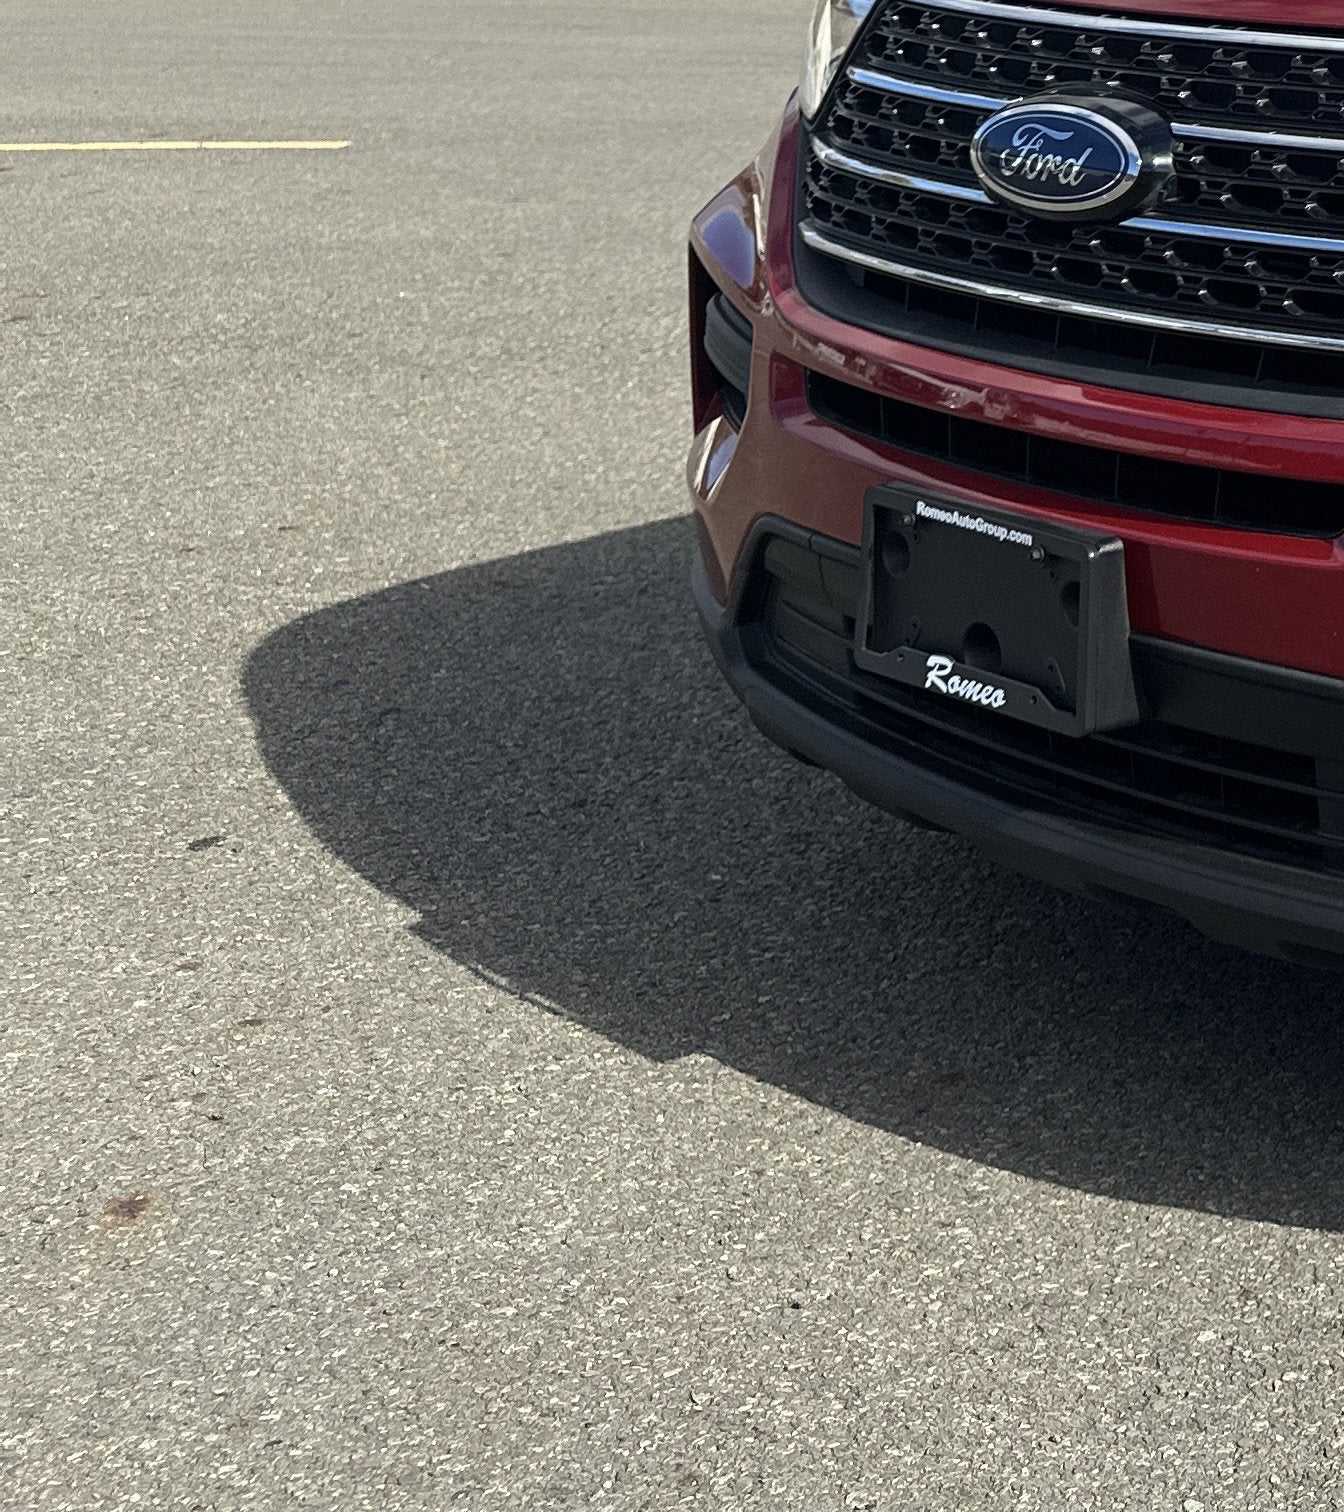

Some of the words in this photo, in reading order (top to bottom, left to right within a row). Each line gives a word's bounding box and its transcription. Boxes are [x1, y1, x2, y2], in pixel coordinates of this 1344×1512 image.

[1000, 123, 1093, 186] Ford
[916, 500, 1033, 546] RomeoAutoGroup.com
[925, 655, 1007, 708] Romeo
